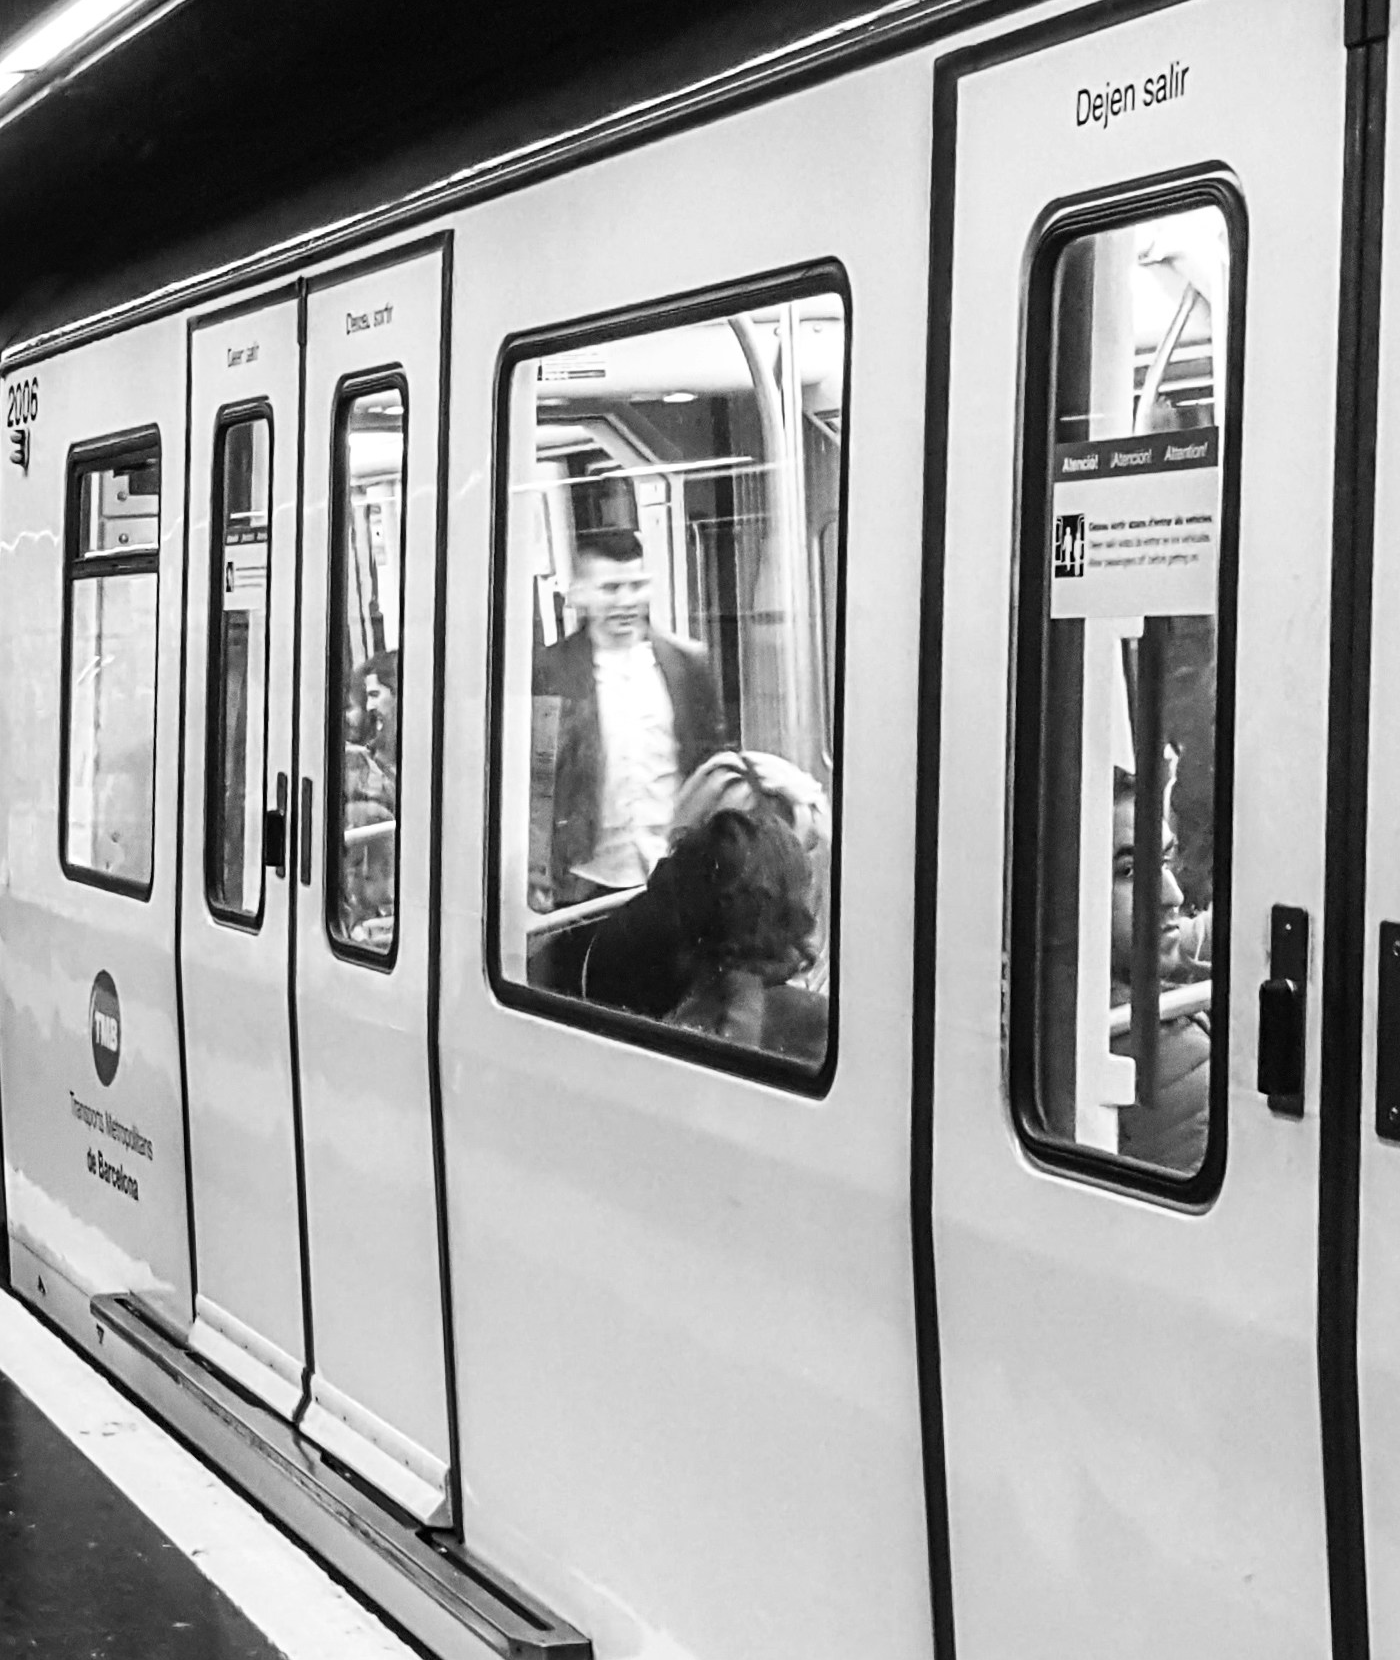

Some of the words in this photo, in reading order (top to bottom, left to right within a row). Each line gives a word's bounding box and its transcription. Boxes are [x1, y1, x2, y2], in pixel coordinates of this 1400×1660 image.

[1076, 81, 1136, 130] Dejen
[1142, 60, 1190, 108] salir
[7, 377, 39, 427] 2006
[94, 1010, 118, 1052] TMB
[97, 1149, 139, 1201] Barcelona
